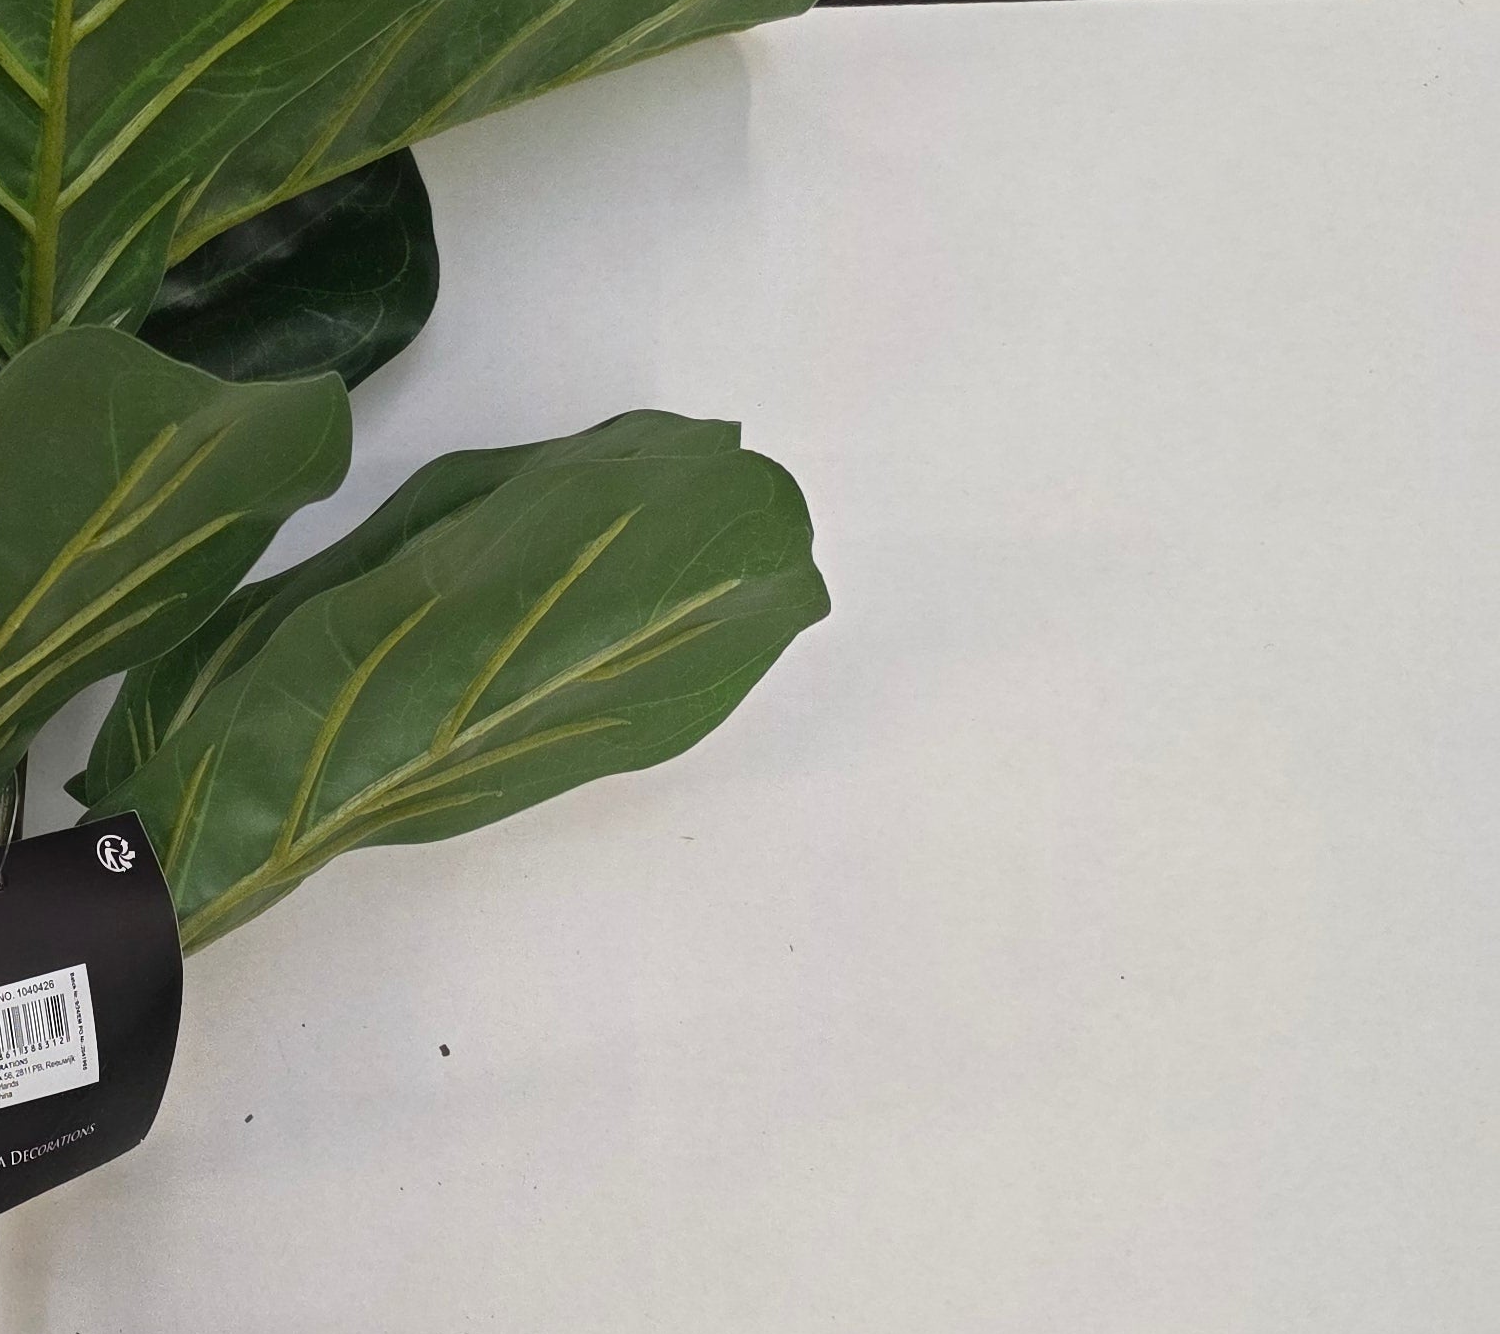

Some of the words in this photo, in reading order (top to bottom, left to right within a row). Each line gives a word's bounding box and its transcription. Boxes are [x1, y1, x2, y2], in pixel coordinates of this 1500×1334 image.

[17, 979, 55, 997] 1040426
[16, 1067, 31, 1078] 2811
[10, 1123, 96, 1166] DECORATIONS
